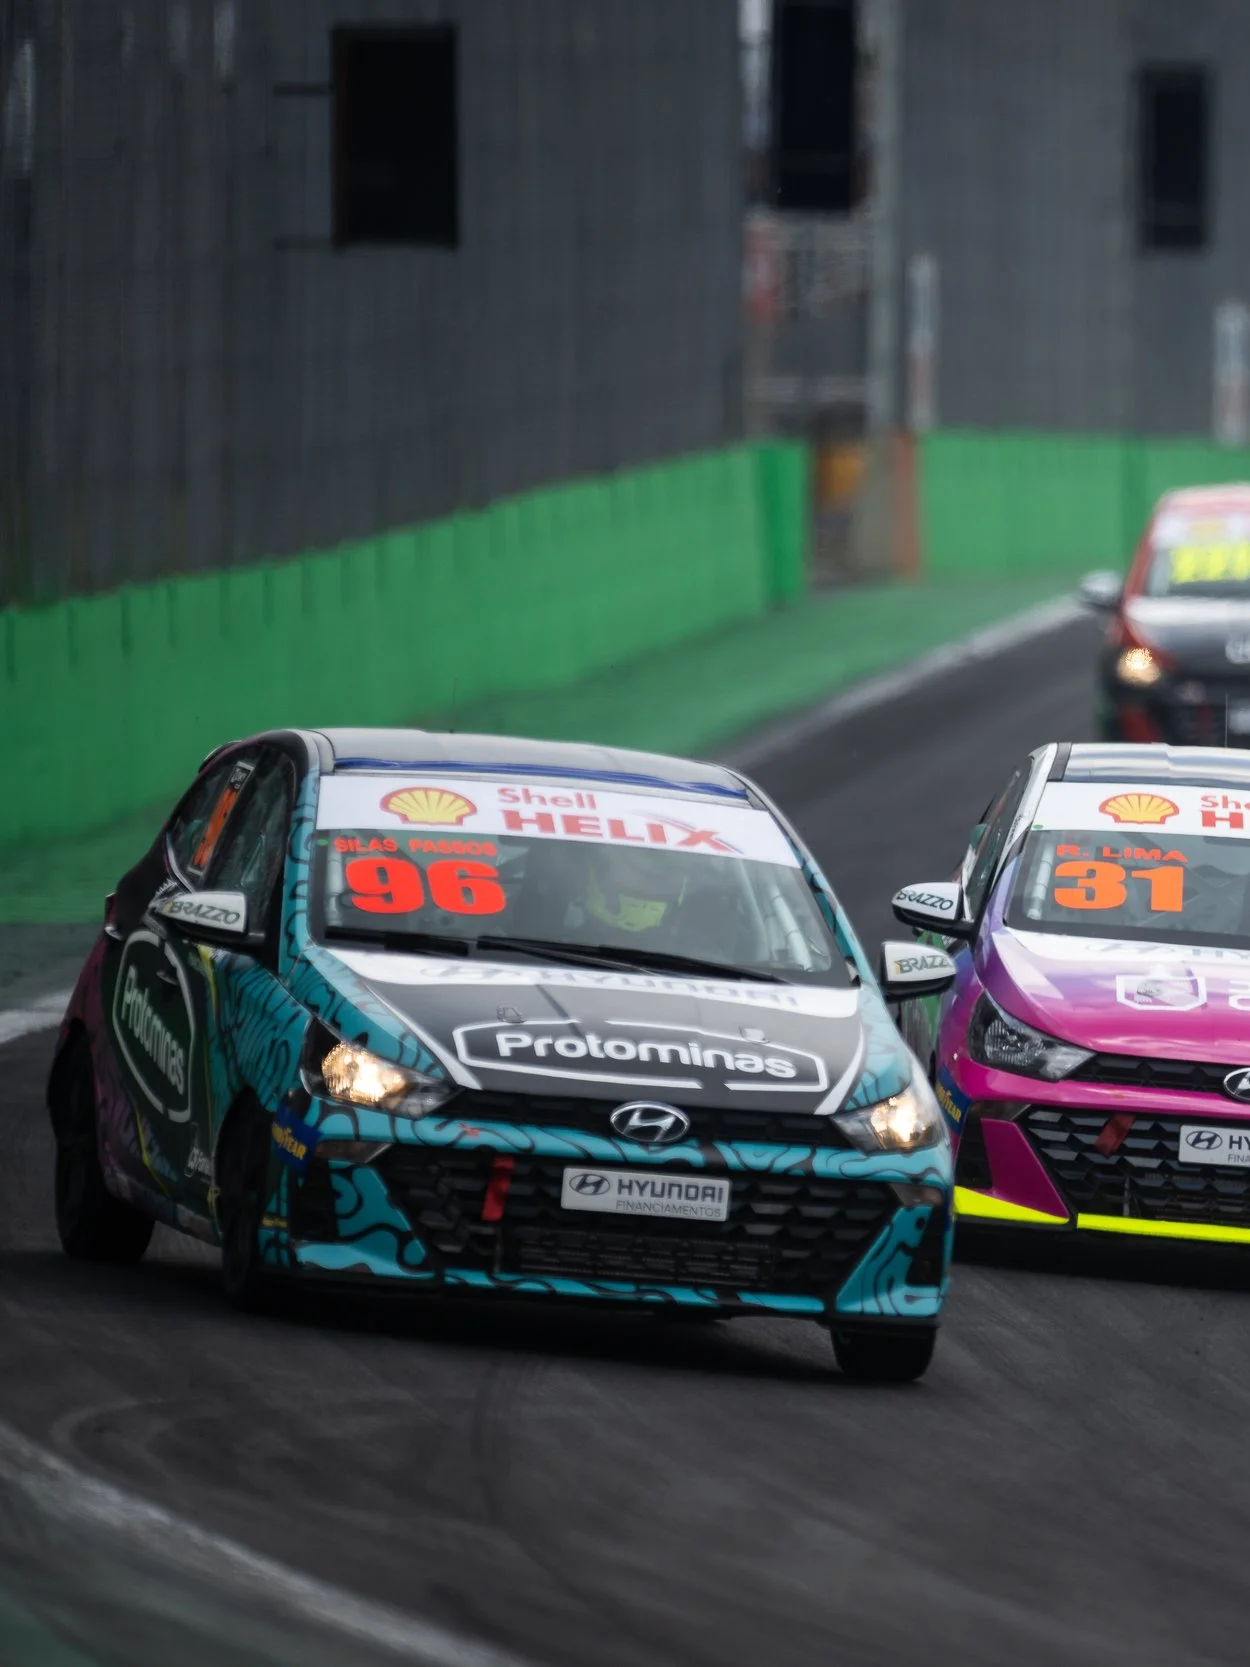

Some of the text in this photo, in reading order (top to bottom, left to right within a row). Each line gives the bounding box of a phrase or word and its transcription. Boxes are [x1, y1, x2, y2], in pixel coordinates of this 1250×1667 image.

[497, 787, 597, 810] Shell
[503, 809, 740, 853] HELIX
[333, 837, 497, 857] SILAS PASSOS
[1057, 844, 1188, 862] R. LIMA
[346, 857, 506, 915] 96
[1054, 860, 1184, 912] 31
[168, 901, 240, 924] BRAZZO
[897, 890, 954, 911] BRAZZO
[121, 965, 184, 1096] Protominas
[495, 1032, 799, 1079] Protominas
[617, 1178, 723, 1203] HYUNDAI
[615, 1200, 721, 1218] FINANCIAMENTOS
